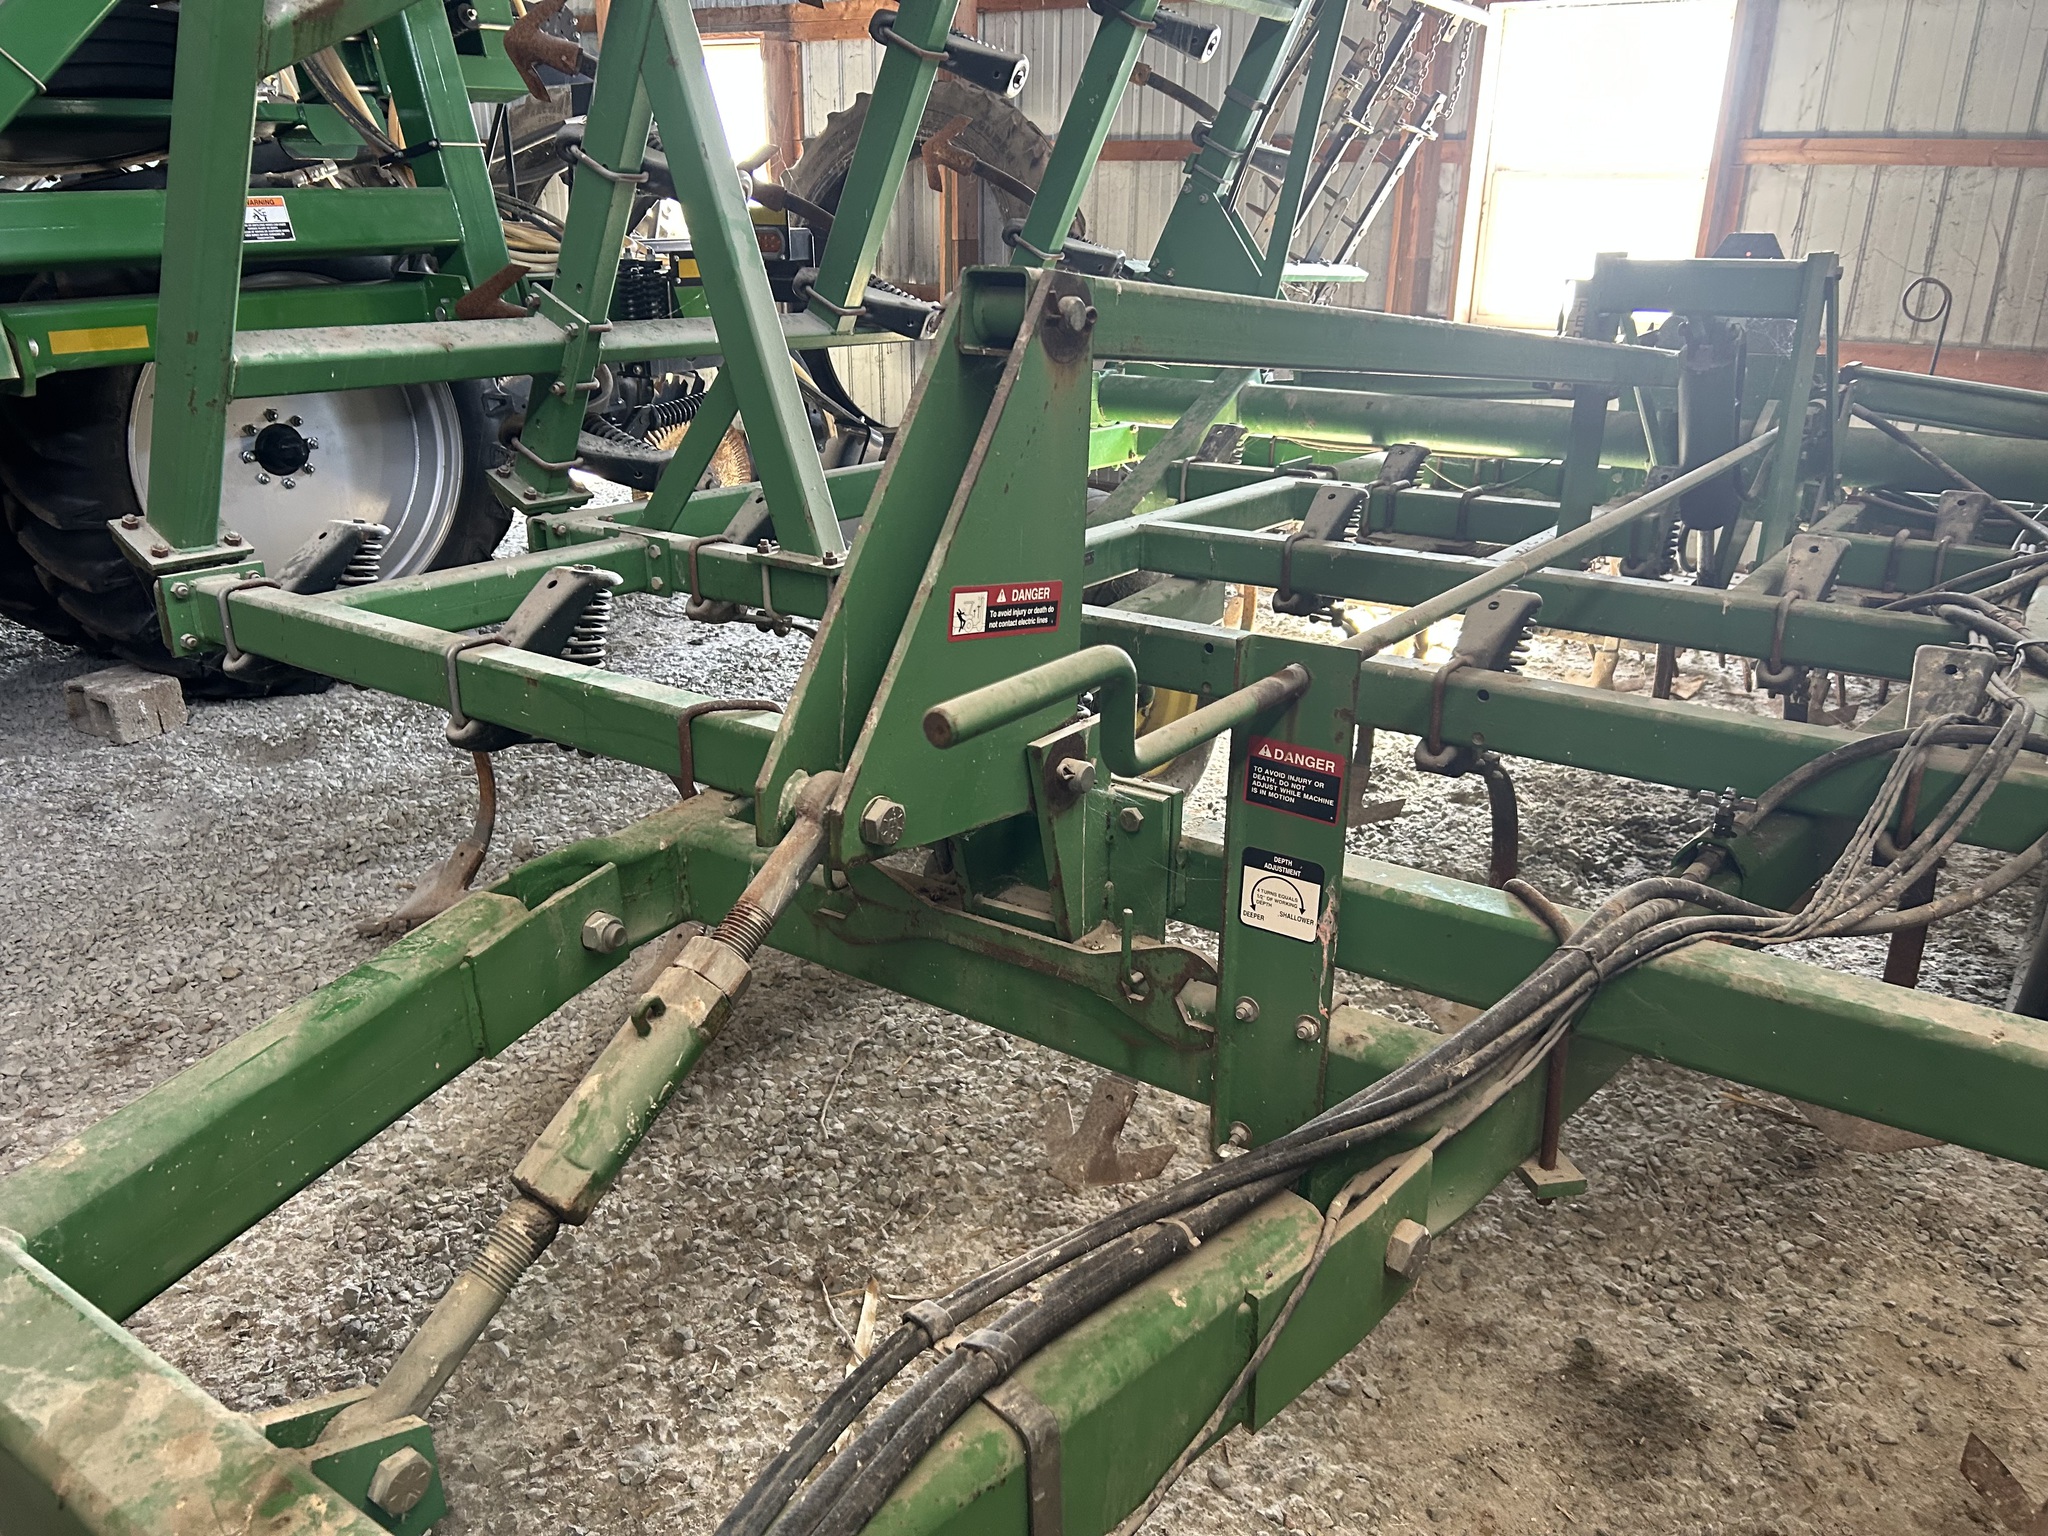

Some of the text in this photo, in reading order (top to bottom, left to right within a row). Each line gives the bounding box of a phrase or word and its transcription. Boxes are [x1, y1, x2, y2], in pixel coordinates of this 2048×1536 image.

[1012, 587, 1050, 601] DANGER
[998, 608, 1012, 617] avoid
[1013, 608, 1026, 617] injury
[1274, 749, 1335, 773] DANGER
[1265, 769, 1285, 778] AVOID
[1288, 775, 1312, 785] INJURY
[1252, 780, 1334, 806] ADJUST WHILE MACHINE
[1291, 783, 1305, 791] NOT
[1268, 792, 1295, 803] MOTION
[1274, 856, 1293, 866] DEPTH
[1264, 862, 1301, 877] ADJUSTMENT
[1262, 889, 1277, 897] TURNS
[1278, 894, 1298, 902] EQUALS
[1274, 899, 1297, 909] WORKING
[1243, 910, 1314, 925] DEEPER SHALLOWER
